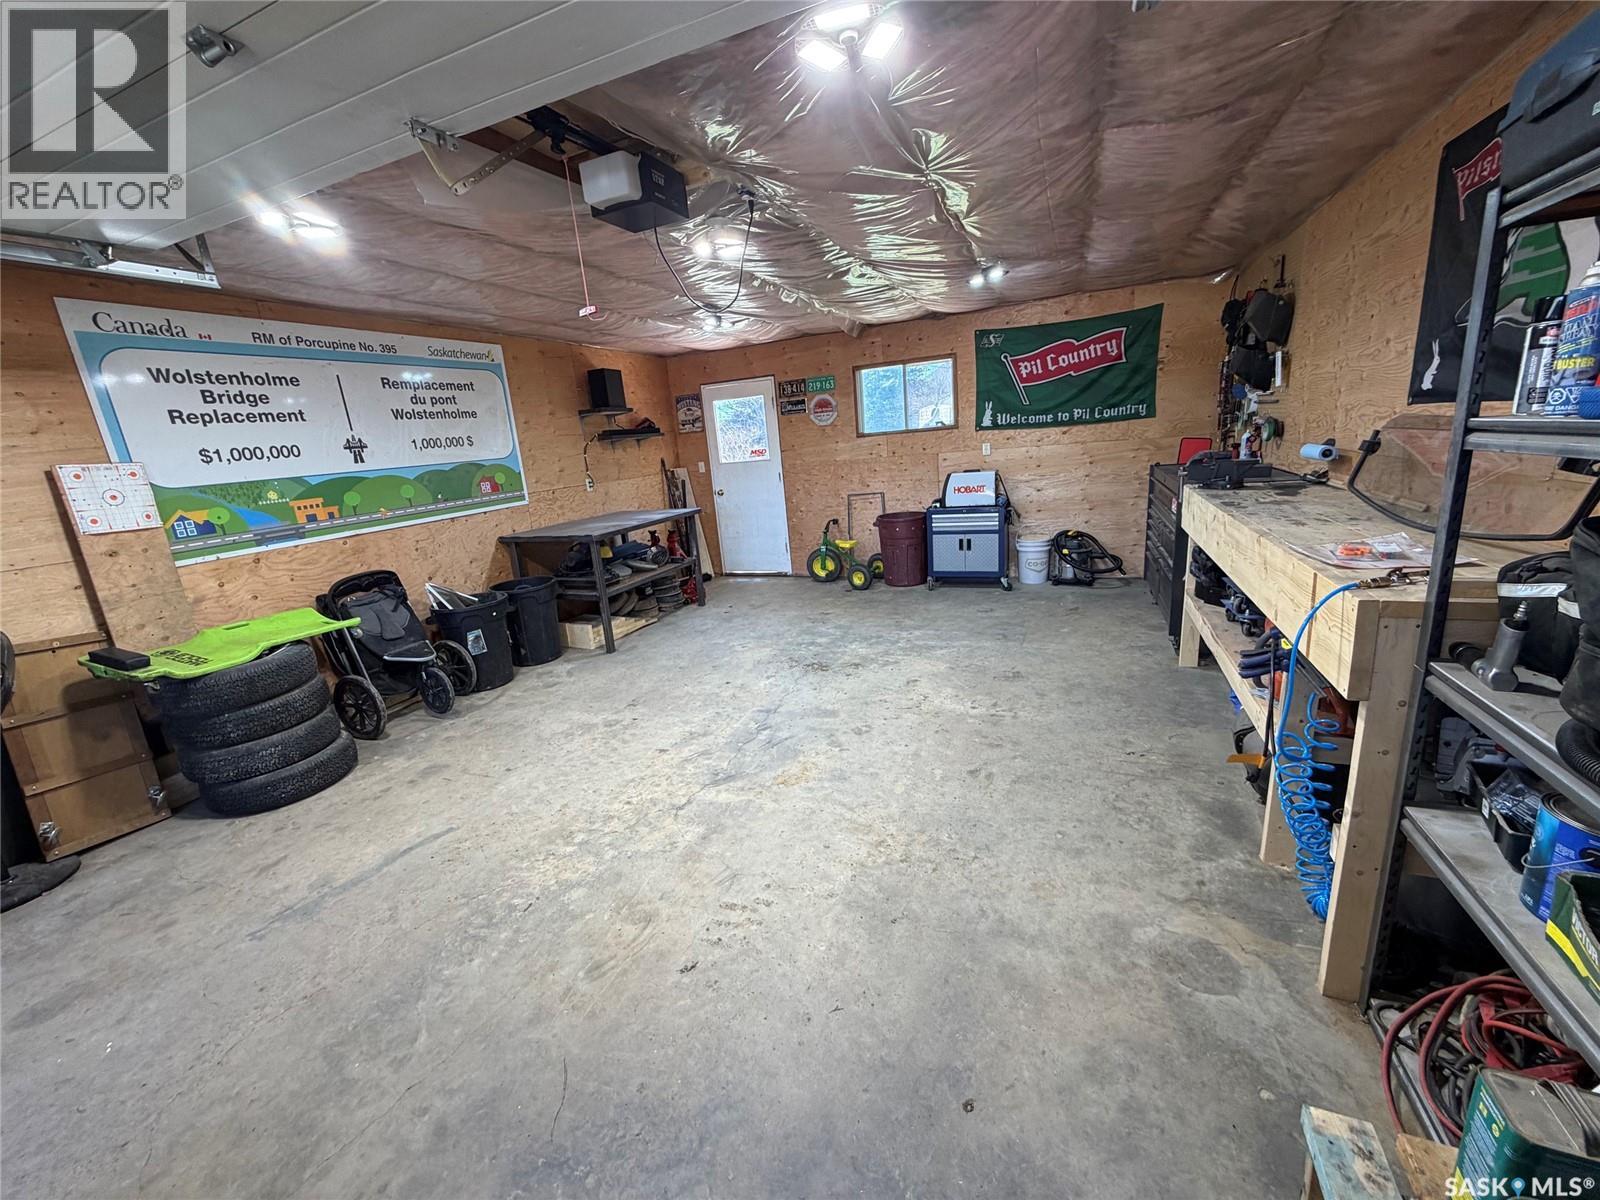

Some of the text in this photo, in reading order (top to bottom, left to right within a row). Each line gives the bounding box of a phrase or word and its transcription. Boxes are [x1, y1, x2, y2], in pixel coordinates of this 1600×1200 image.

[92, 311, 189, 339] Canada
[251, 332, 398, 354] RM of Porcupine No. 395
[427, 346, 486, 361] Saskatchewan
[1018, 338, 1118, 378] Pil Country
[147, 367, 300, 387] Wolstenholme
[380, 377, 476, 392] Remplacement
[200, 389, 270, 407] Bridge
[410, 394, 457, 407] du pont
[167, 409, 307, 427] Replacement
[391, 408, 478, 420] Wolstenholme
[997, 403, 1148, 425] Welcome to Pil Country
[411, 435, 474, 451] 1,000,000 $
[198, 444, 301, 465] $1,000,000
[953, 485, 986, 494] HOBART
